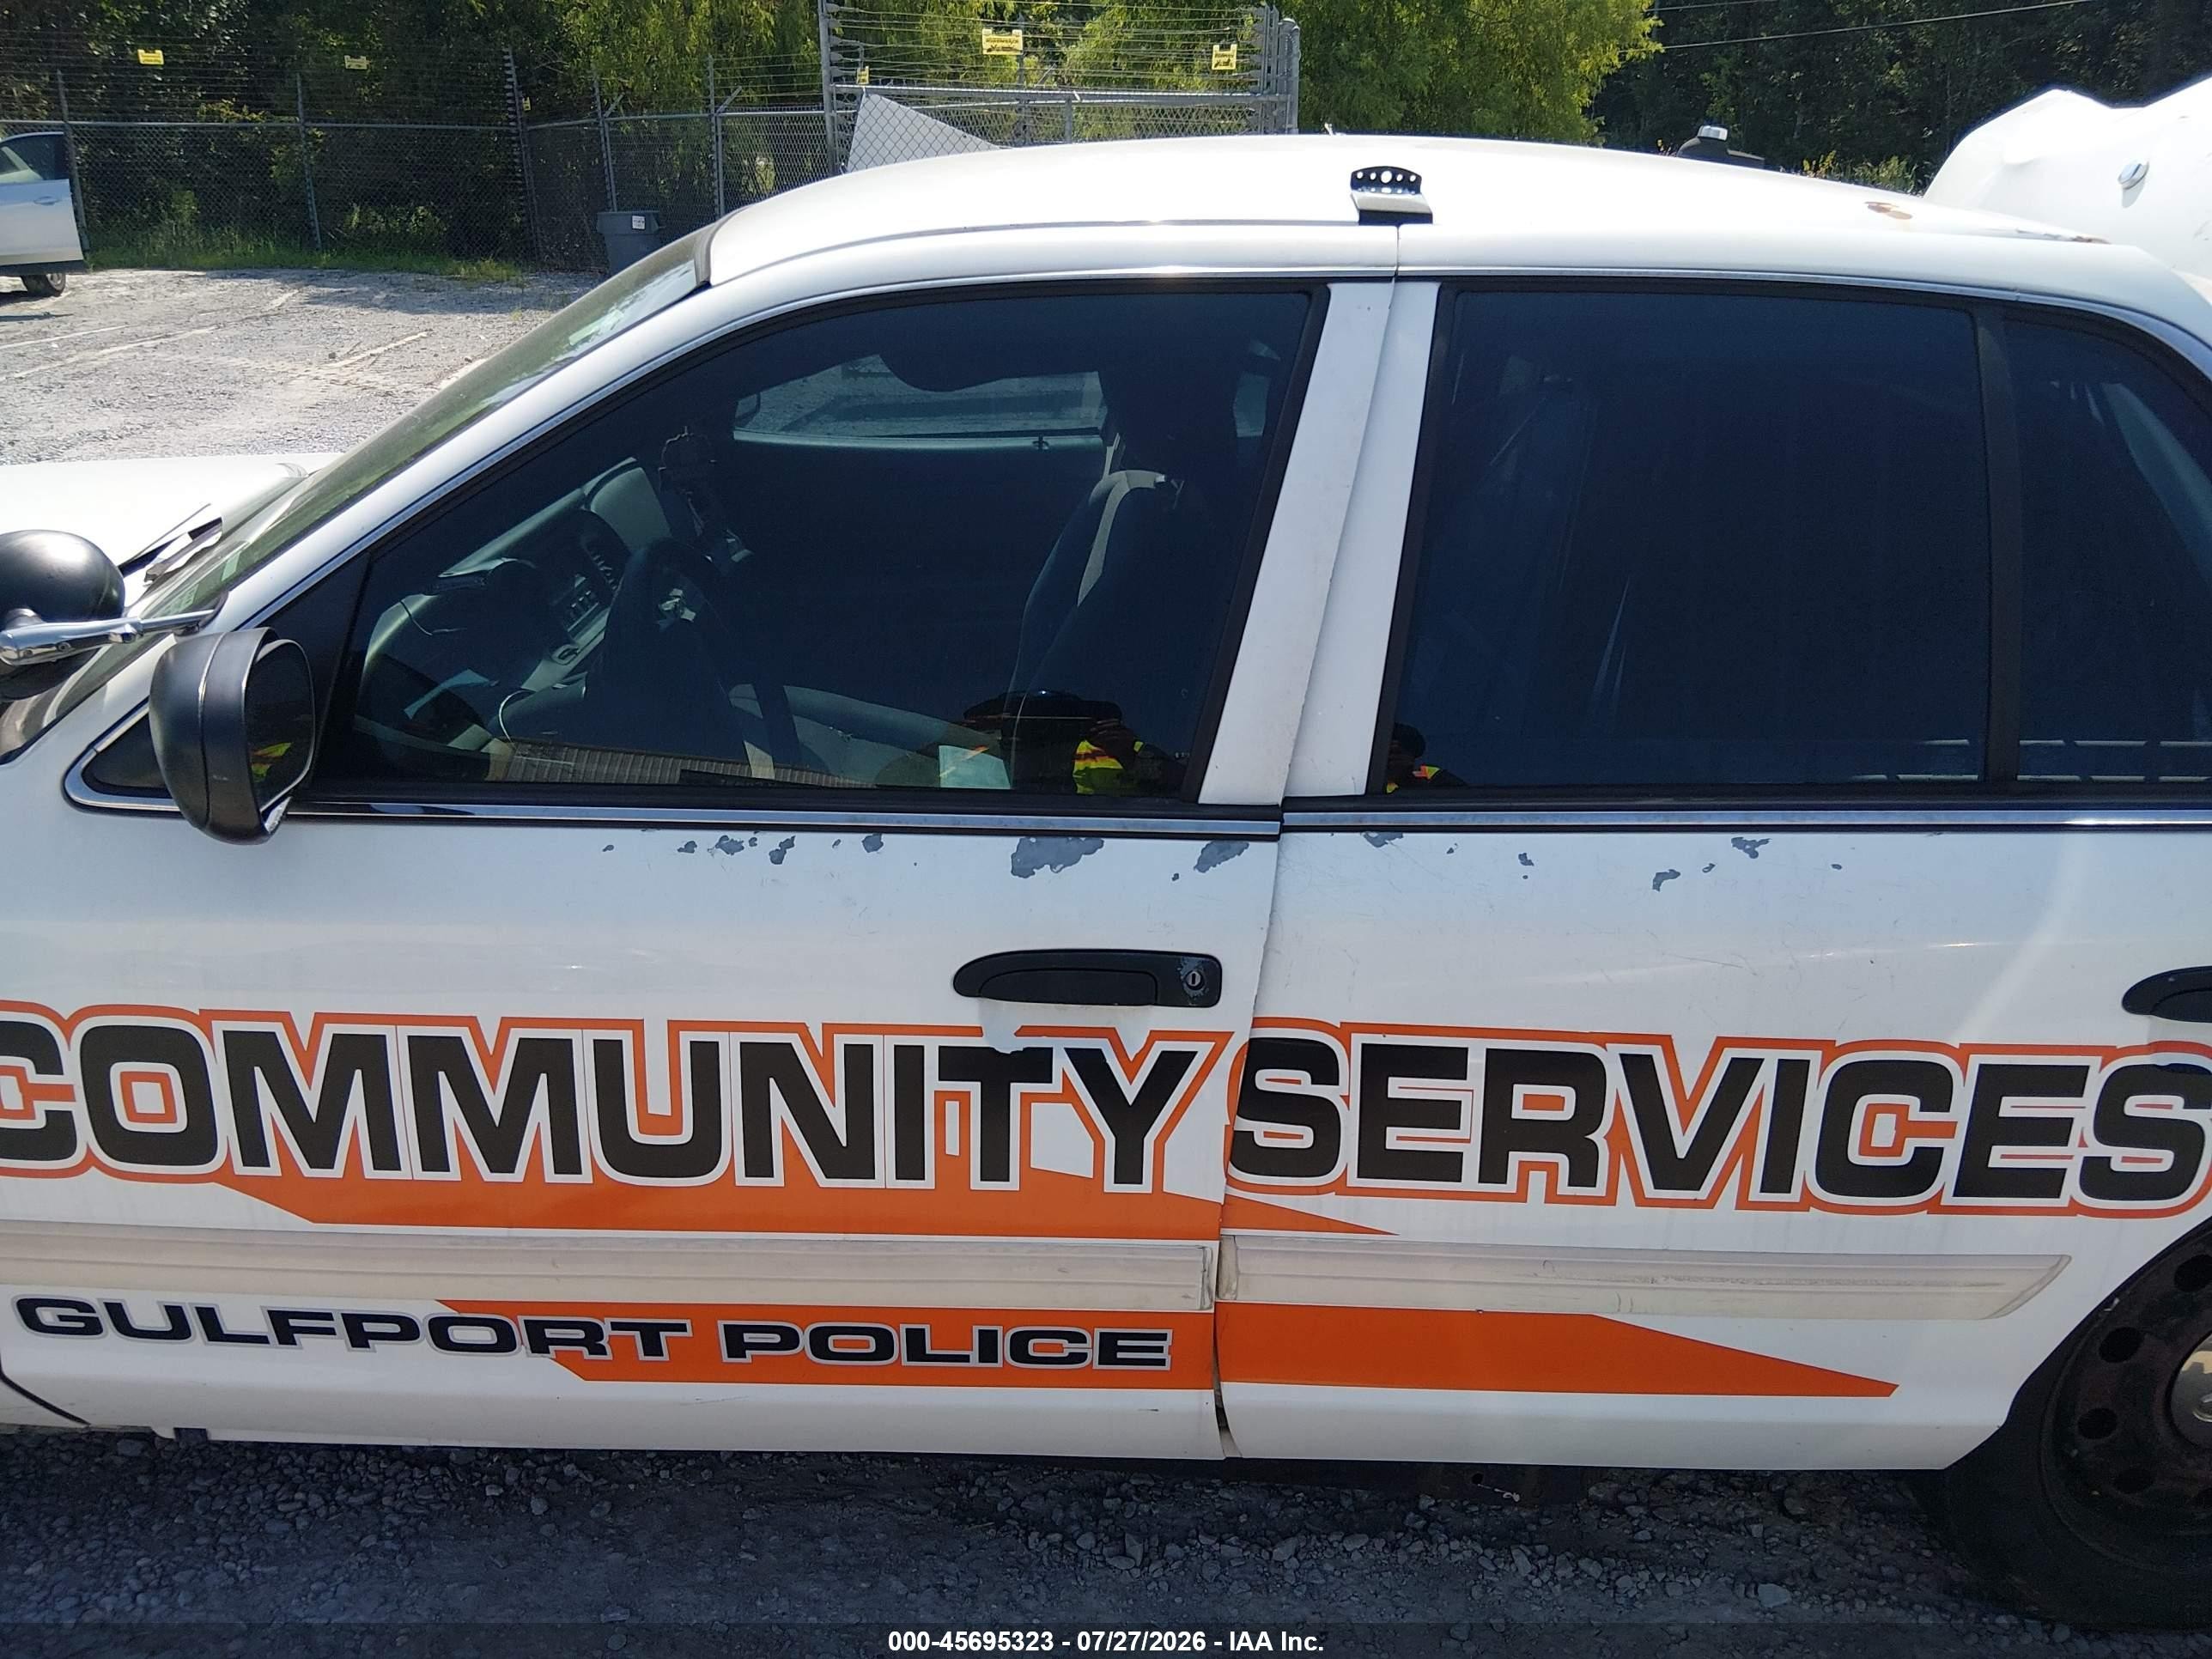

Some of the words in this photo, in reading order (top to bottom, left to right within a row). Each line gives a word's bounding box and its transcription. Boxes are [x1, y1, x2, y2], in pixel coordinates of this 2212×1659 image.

[0, 1020, 1199, 1186] COMMUNITY
[1227, 1036, 2212, 1202] SERVICES
[15, 1297, 690, 1359] GULFPORT
[721, 1322, 1170, 1369] POLICE
